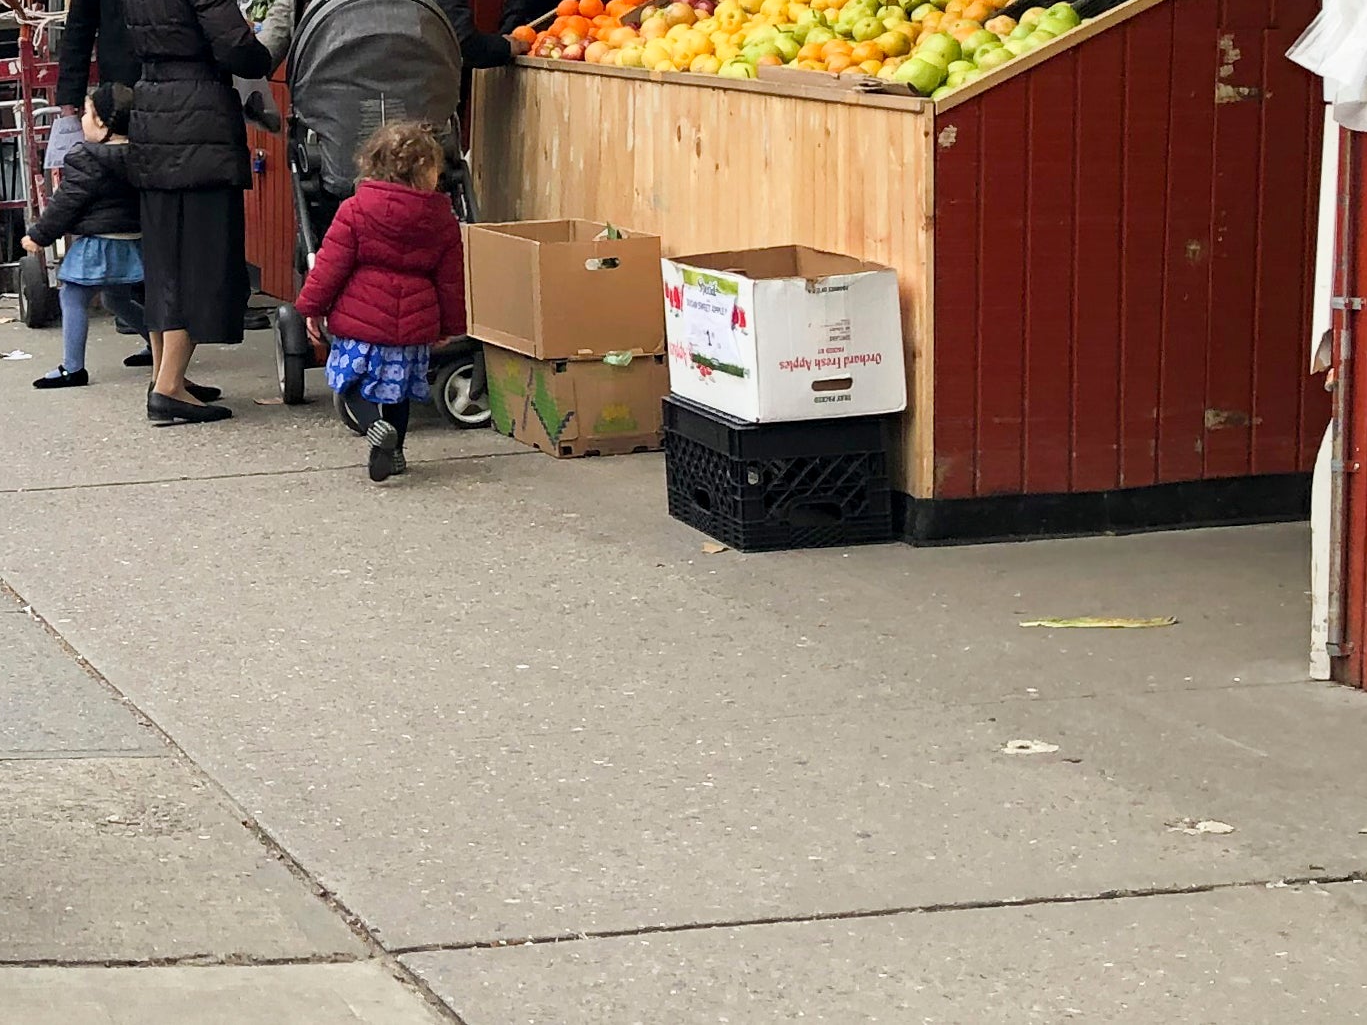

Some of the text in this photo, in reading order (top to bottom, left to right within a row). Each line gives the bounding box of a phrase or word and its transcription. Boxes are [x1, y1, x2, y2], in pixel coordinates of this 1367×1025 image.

[778, 352, 882, 372] Orchard Fresh Apples
